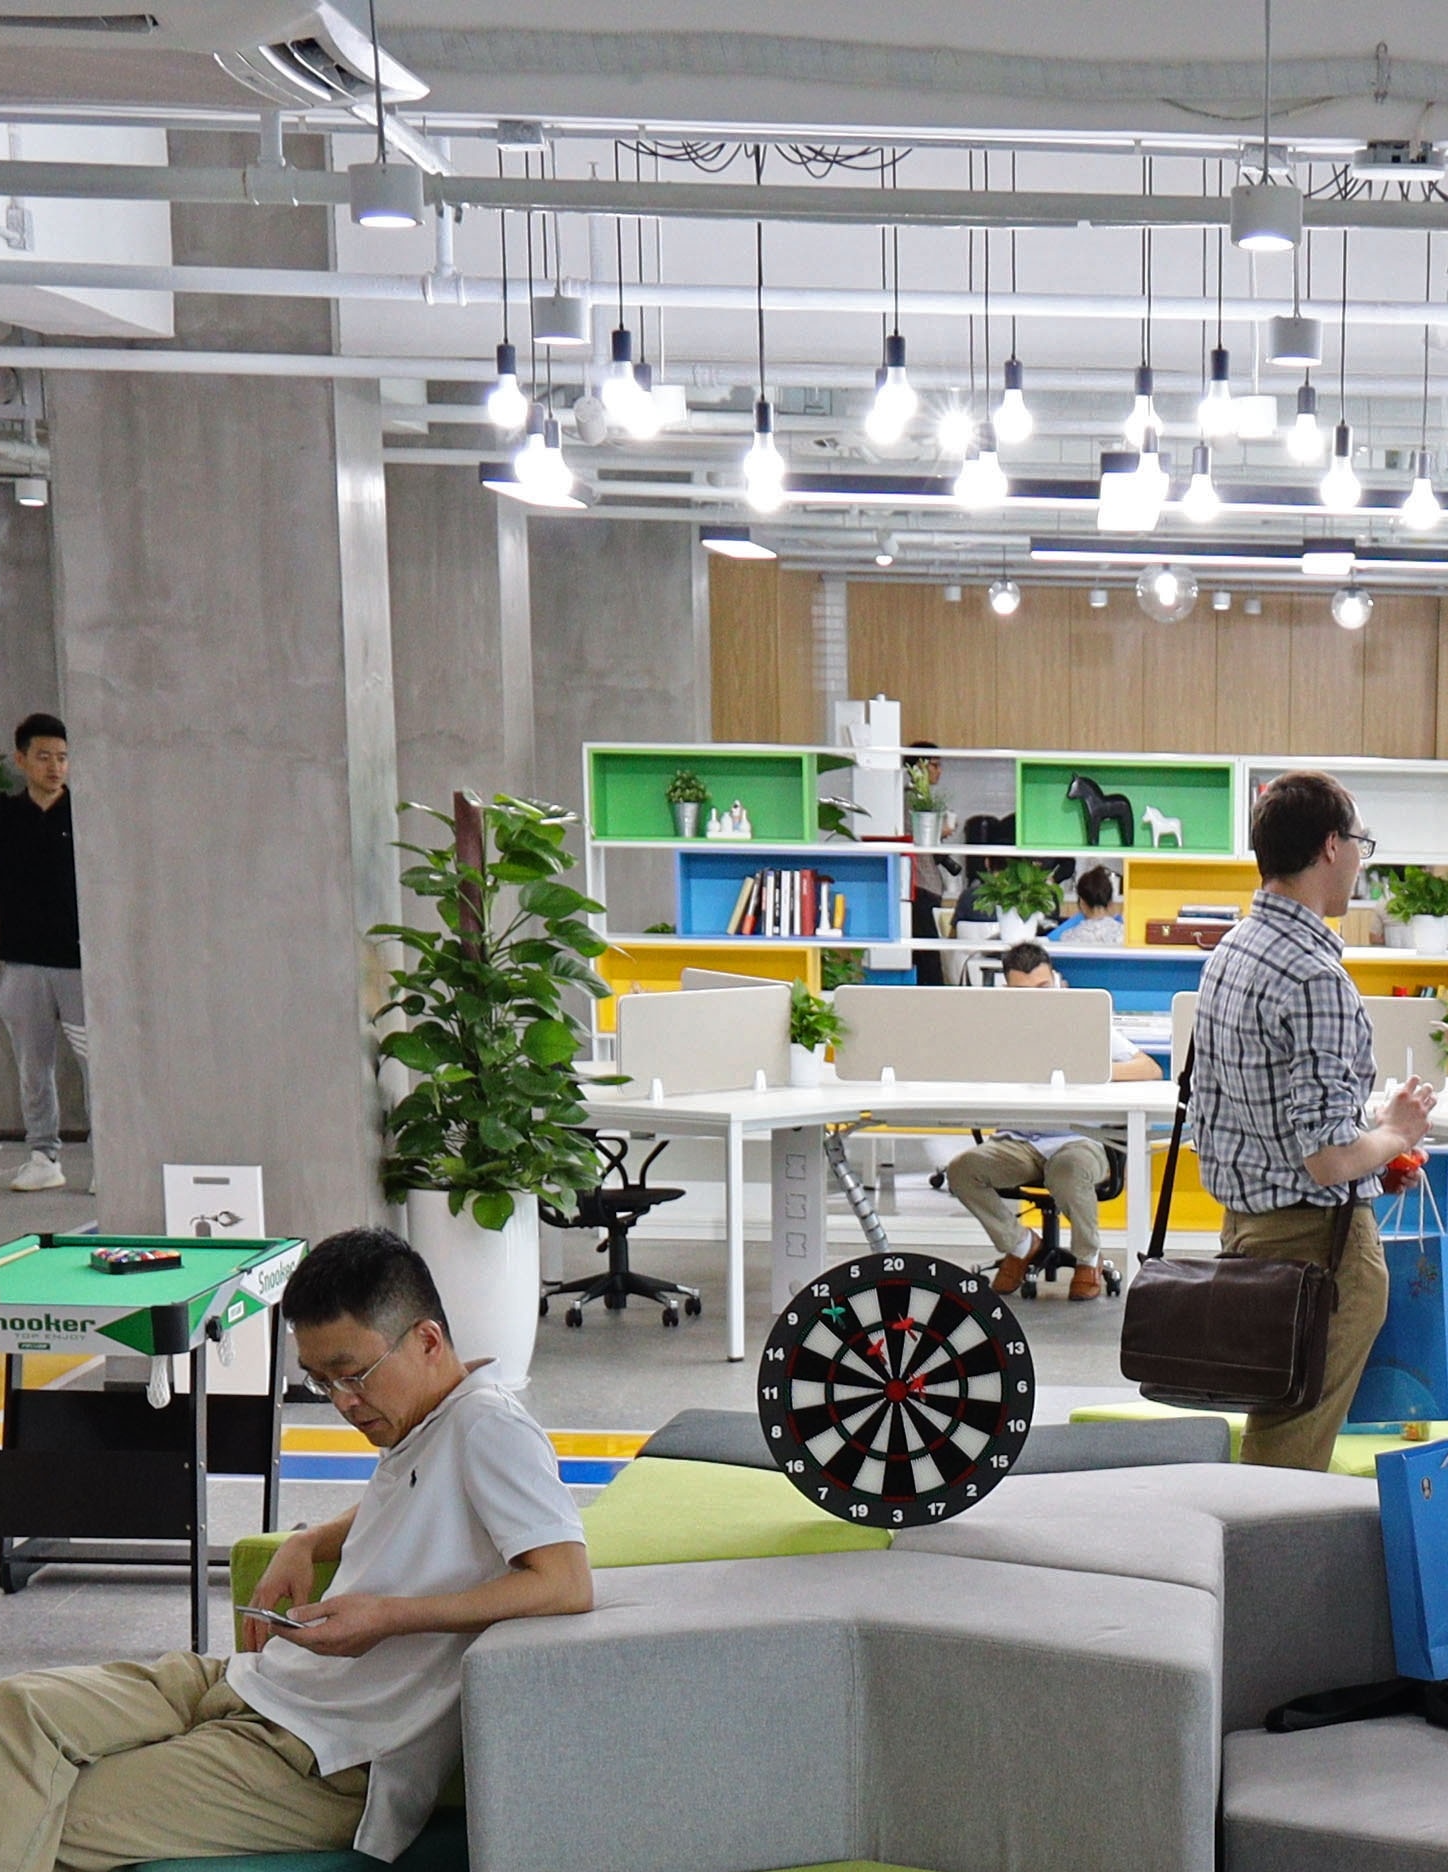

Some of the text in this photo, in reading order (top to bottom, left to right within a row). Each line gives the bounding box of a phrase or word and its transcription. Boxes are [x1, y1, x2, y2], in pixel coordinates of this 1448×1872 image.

[884, 1257, 904, 1271] 20
[929, 1263, 937, 1276] 1
[850, 1265, 860, 1278] 5
[811, 1284, 830, 1297] 12
[959, 1280, 978, 1293] 18
[787, 1313, 798, 1325] 9
[992, 1307, 1002, 1320] 4
[44, 1333, 85, 1341] ENJOY
[766, 1347, 785, 1361] 14
[1006, 1341, 1025, 1354] 13
[762, 1387, 778, 1400] 11
[1017, 1381, 1028, 1393] 6
[771, 1426, 782, 1438] 8
[1007, 1420, 1026, 1433] 10
[785, 1460, 804, 1473] 16
[990, 1455, 1009, 1468] 15
[818, 1487, 829, 1500] 7
[967, 1484, 978, 1497] 2
[849, 1504, 869, 1518] 19
[893, 1509, 903, 1522] 3
[928, 1503, 946, 1515] 17
